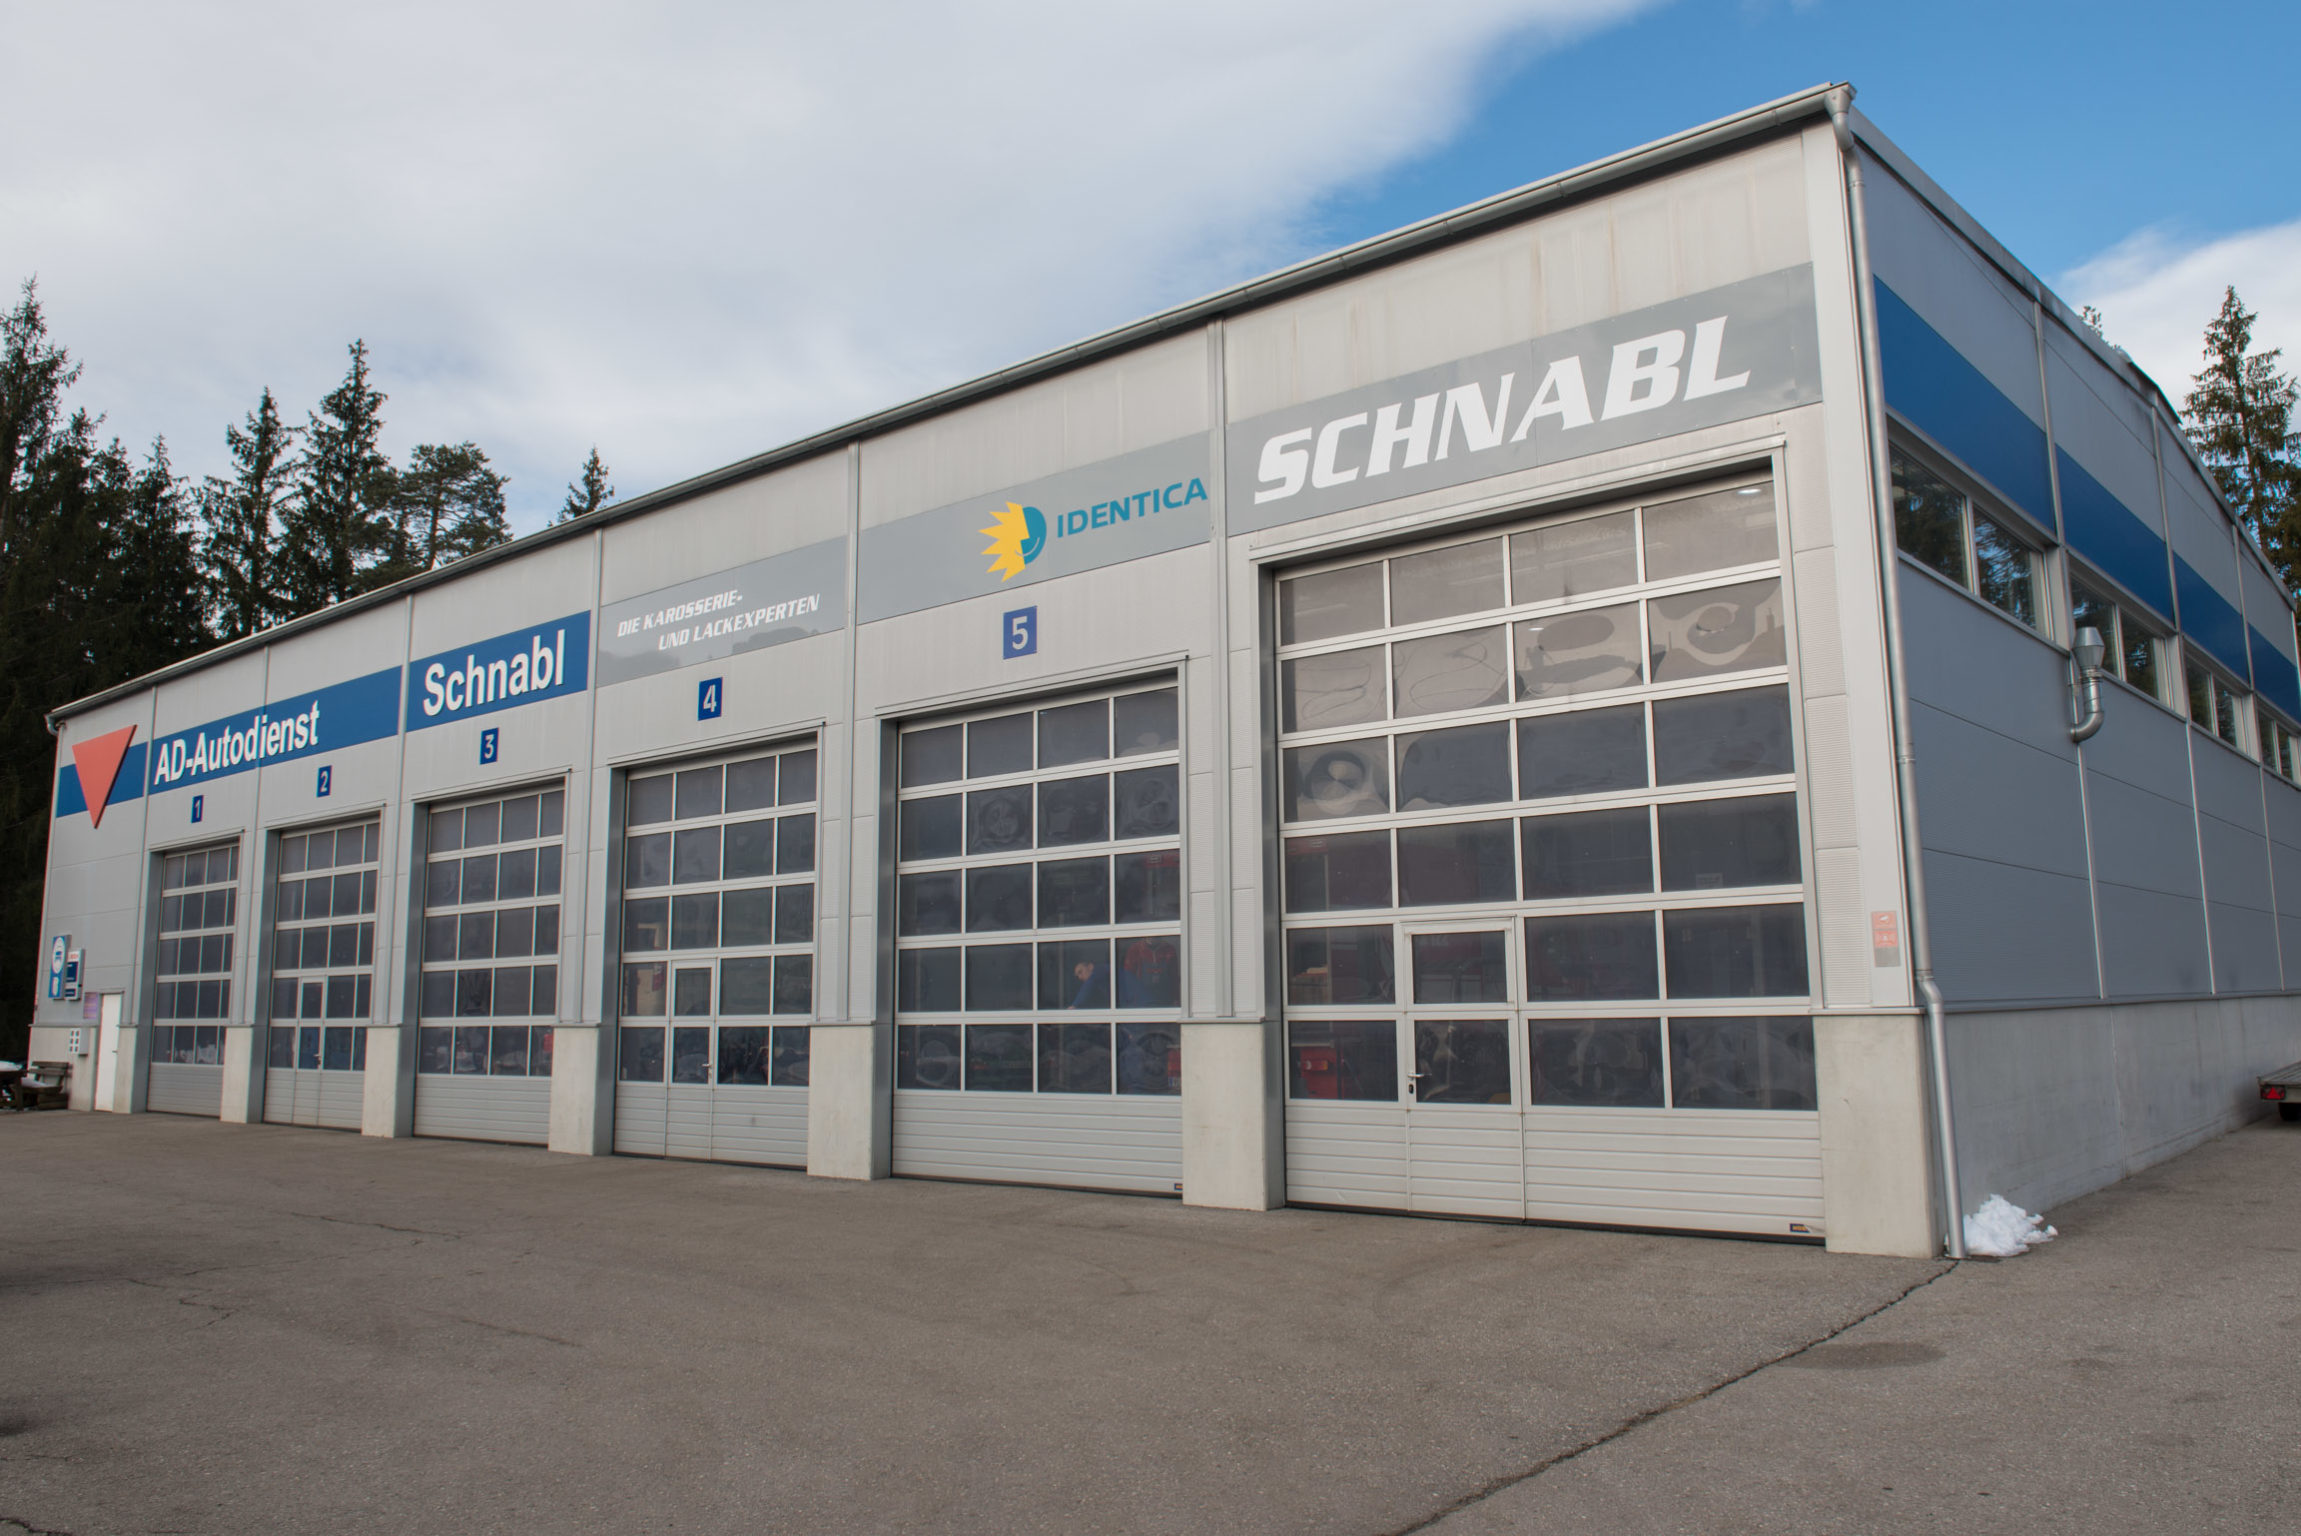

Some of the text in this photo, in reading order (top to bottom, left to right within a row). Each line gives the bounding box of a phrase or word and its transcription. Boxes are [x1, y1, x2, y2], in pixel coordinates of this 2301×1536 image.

[1254, 316, 1751, 504] SCHNABL
[1056, 477, 1208, 538] IDENTICA
[617, 616, 641, 637] DIE
[658, 593, 821, 651] UND LACKEXPERTEN
[1011, 615, 1029, 650] 5
[423, 629, 567, 717] Schnabl
[703, 684, 718, 713] 4
[154, 700, 321, 786] AD-Autodienst
[484, 734, 495, 759] 3
[320, 770, 329, 793] 2
